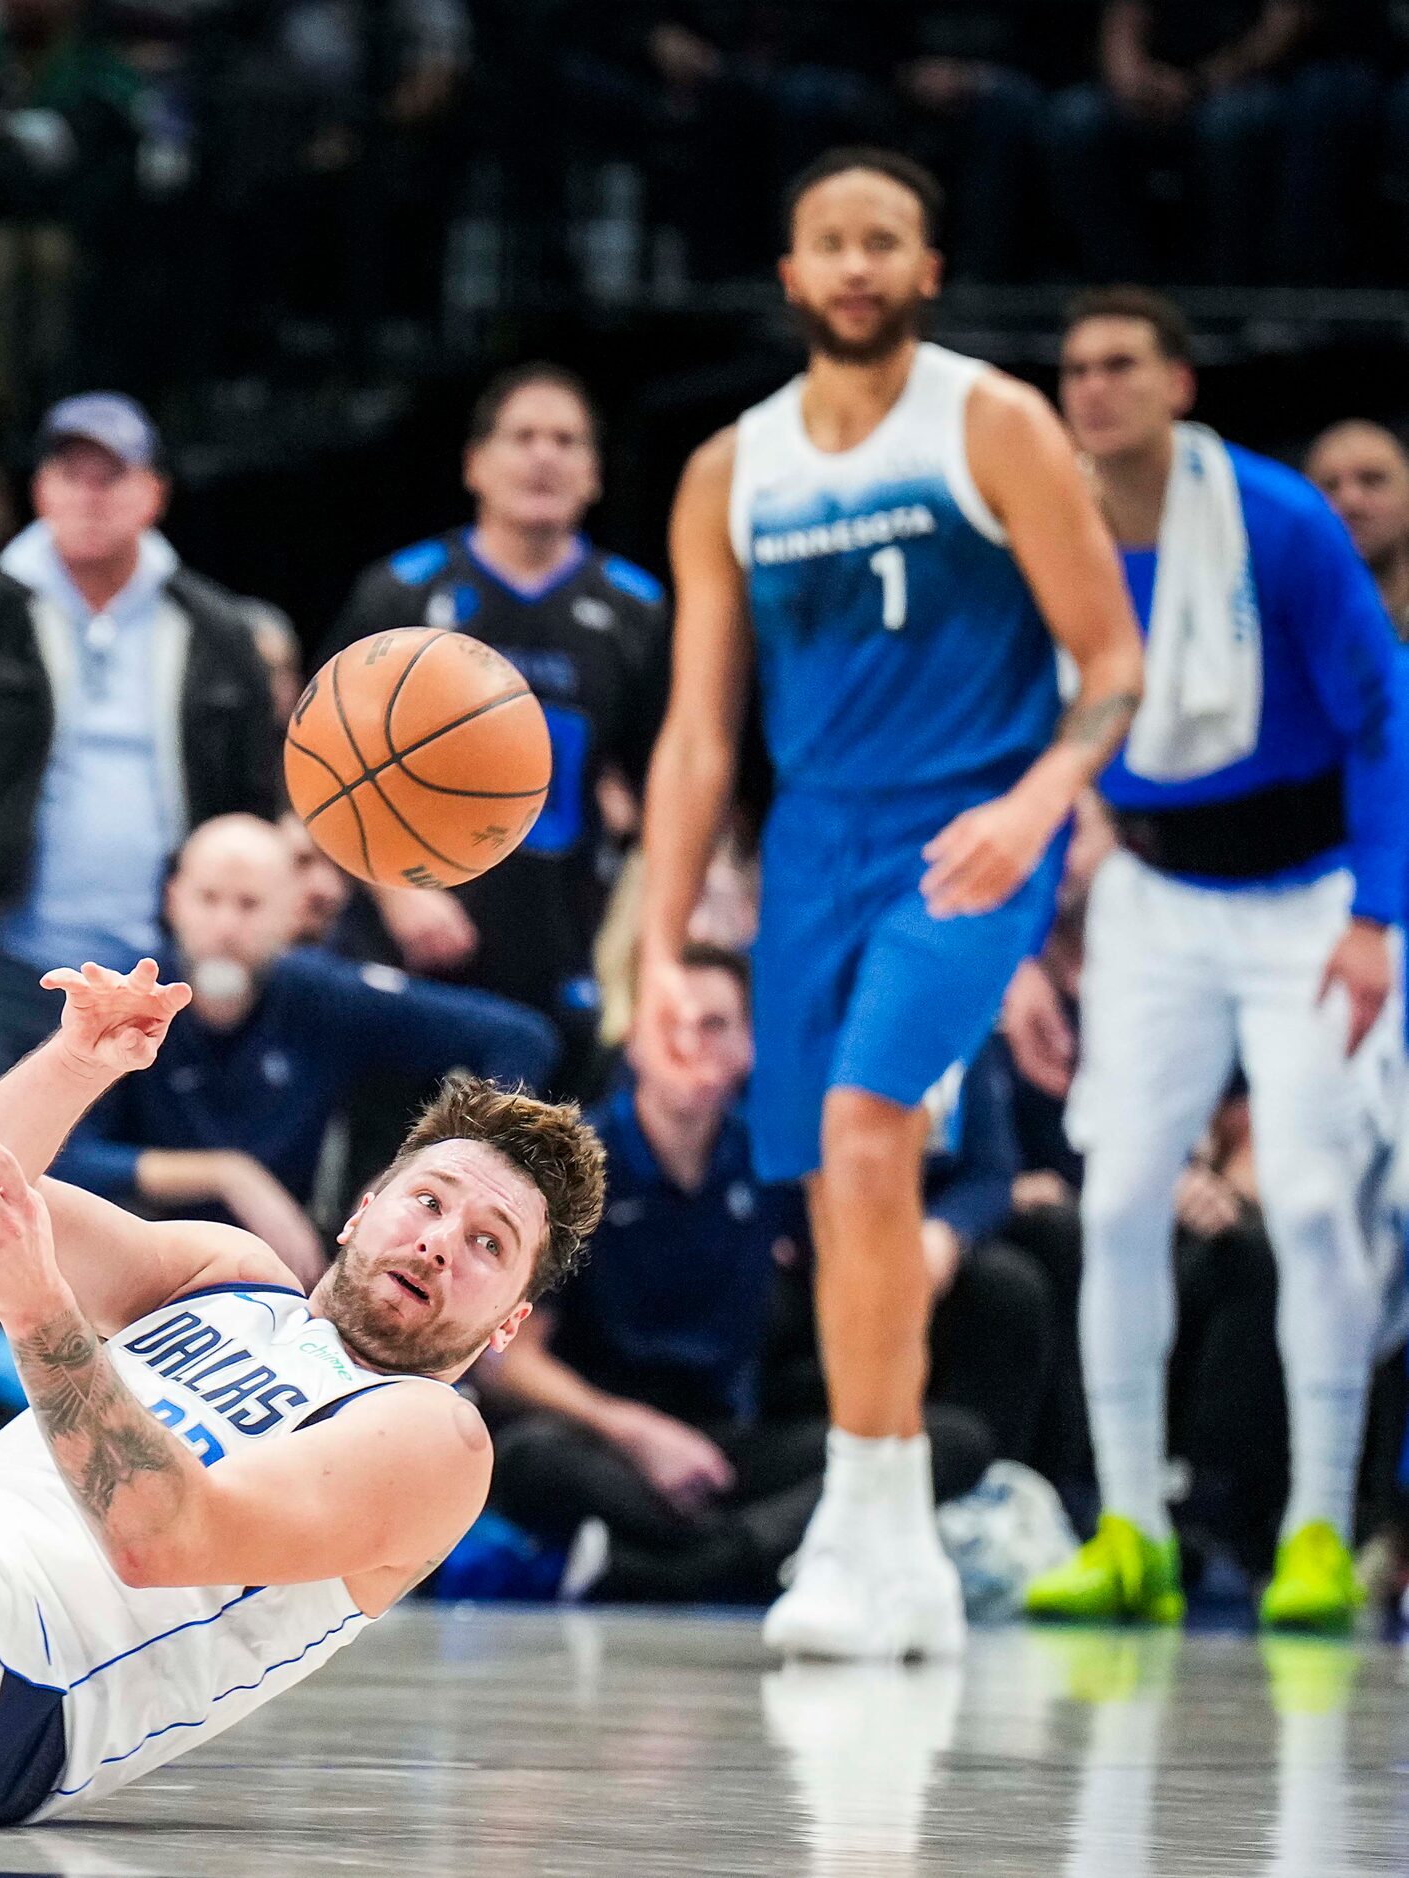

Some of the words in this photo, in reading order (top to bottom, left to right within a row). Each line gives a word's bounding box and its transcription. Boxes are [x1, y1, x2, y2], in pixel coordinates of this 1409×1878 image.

[754, 503, 937, 567] MINNESOTA
[869, 545, 907, 631] 1
[121, 1311, 310, 1436] DALLAS
[299, 1341, 353, 1383] chime
